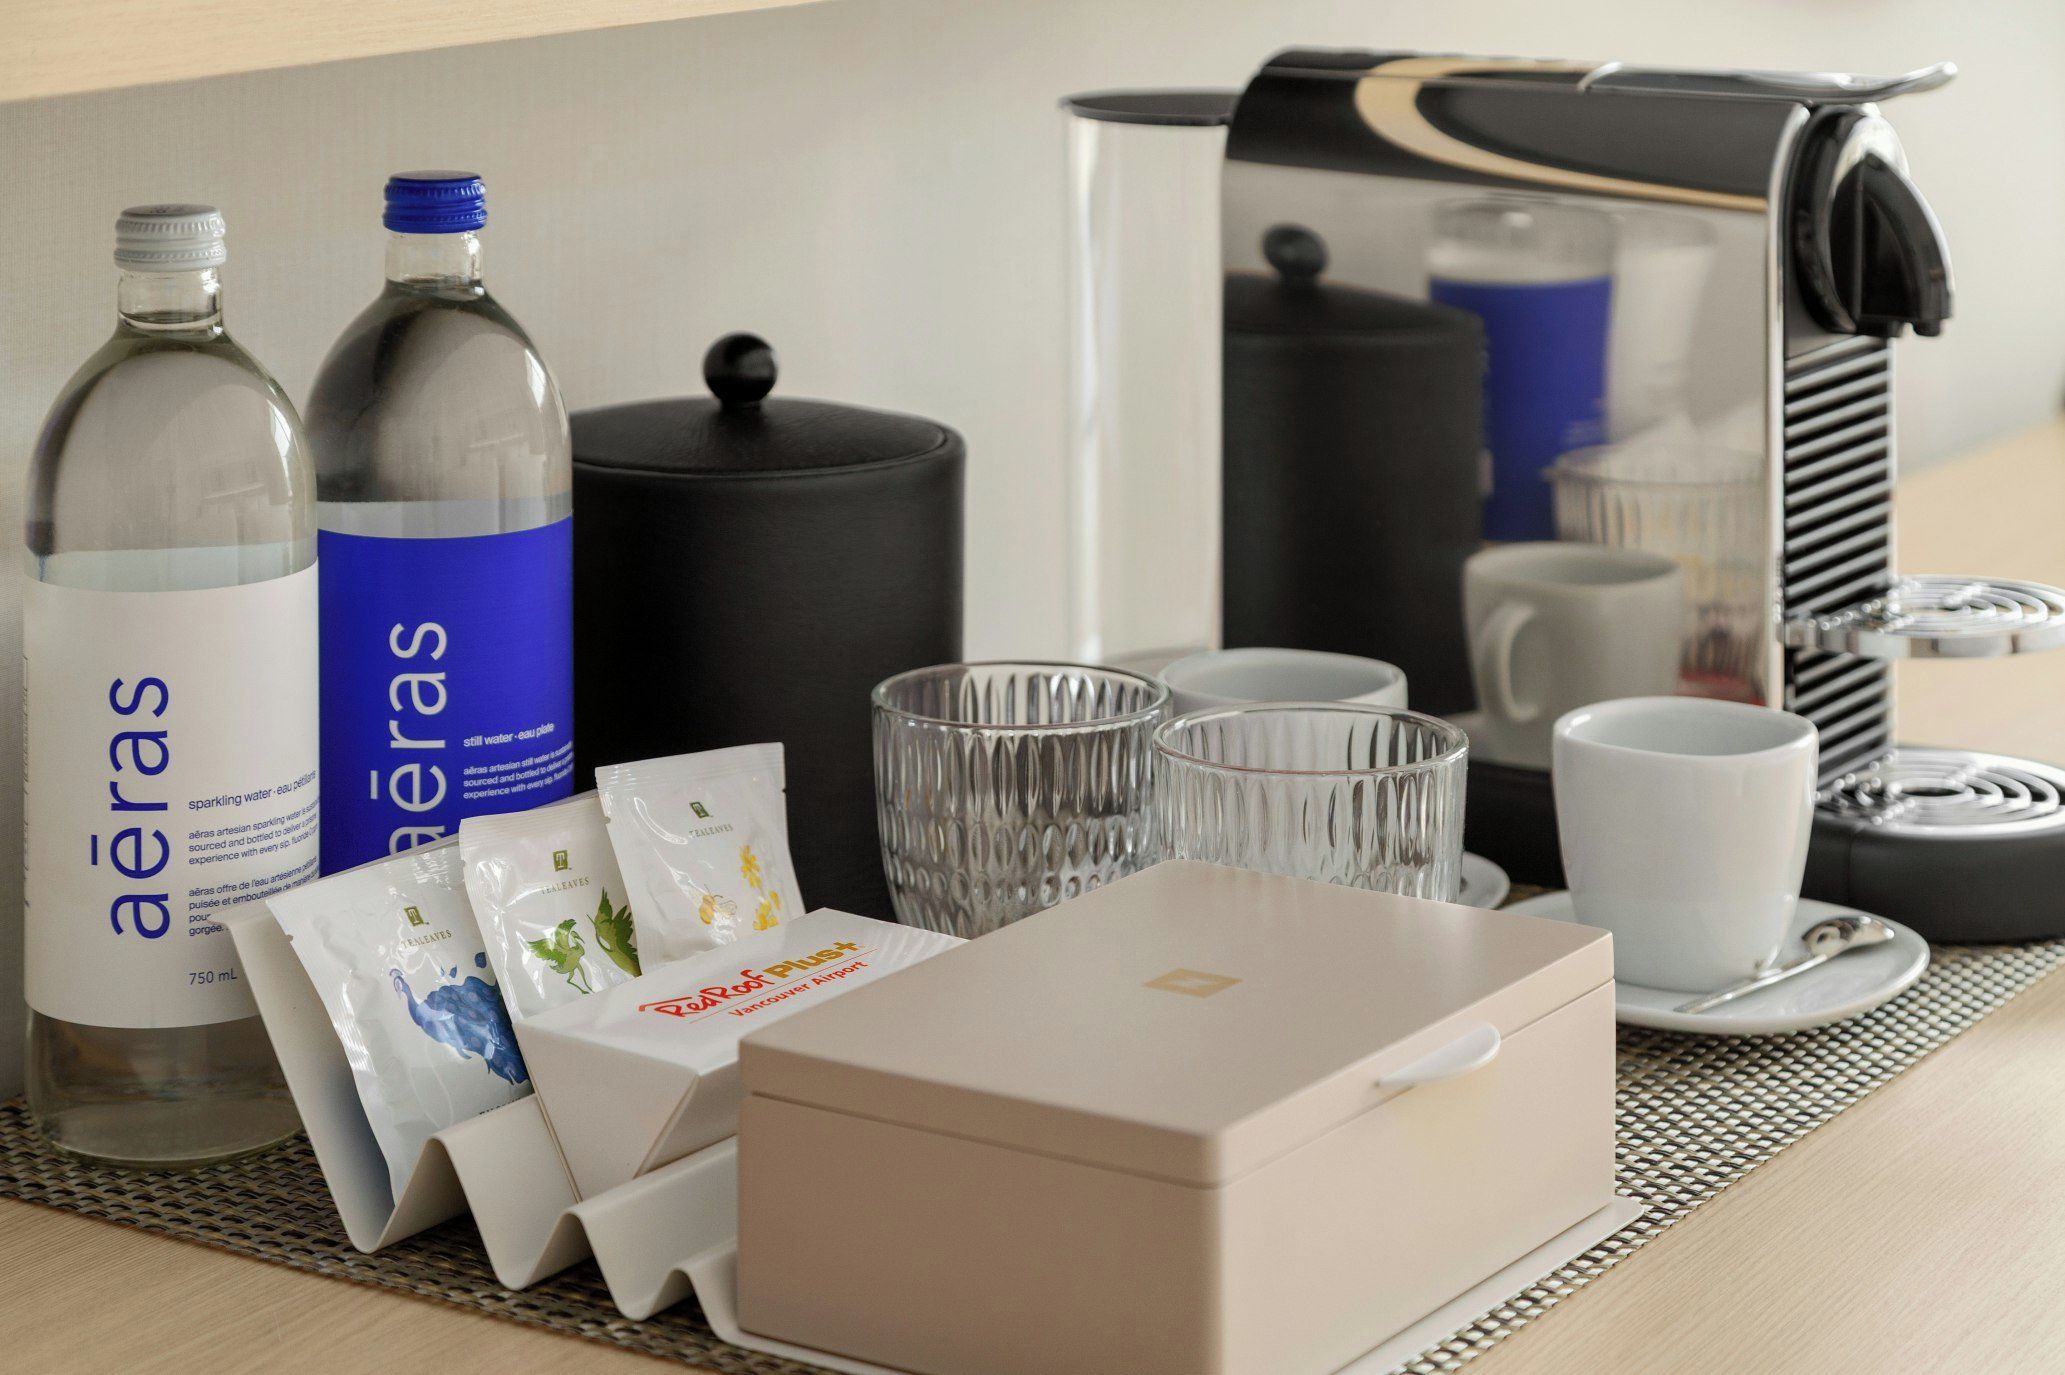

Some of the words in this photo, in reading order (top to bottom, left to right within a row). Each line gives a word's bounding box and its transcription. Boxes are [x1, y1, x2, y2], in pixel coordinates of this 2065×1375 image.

[463, 735, 483, 747] still
[484, 733, 514, 745] water
[518, 728, 536, 740] eau
[536, 722, 555, 738] plate
[489, 761, 520, 773] artesian
[521, 757, 534, 767] still
[463, 776, 498, 787] sourced
[499, 773, 515, 783] and
[516, 767, 540, 780] bottled
[189, 795, 242, 811] sparkling
[244, 789, 272, 802] water
[276, 784, 292, 795] eau
[463, 786, 510, 800] experience
[511, 782, 526, 793] with
[527, 778, 544, 790] every
[91, 677, 170, 939] aēras
[216, 824, 251, 837] artesian
[252, 816, 285, 832] sparkling
[286, 810, 301, 821] water
[189, 840, 226, 852] sourced
[228, 837, 245, 848] and
[246, 831, 273, 845] bottled
[275, 828, 281, 838] to
[282, 822, 302, 835] deliver
[189, 852, 239, 866] experience
[240, 847, 258, 858] with
[259, 843, 279, 855] every
[216, 882, 237, 894] offre
[238, 880, 250, 890] de
[189, 898, 220, 911] puisée
[222, 896, 231, 906] et
[189, 970, 214, 985] 750
[218, 968, 237, 981] mL
[728, 981, 811, 1018] Vancouver
[811, 960, 868, 986] Airport
